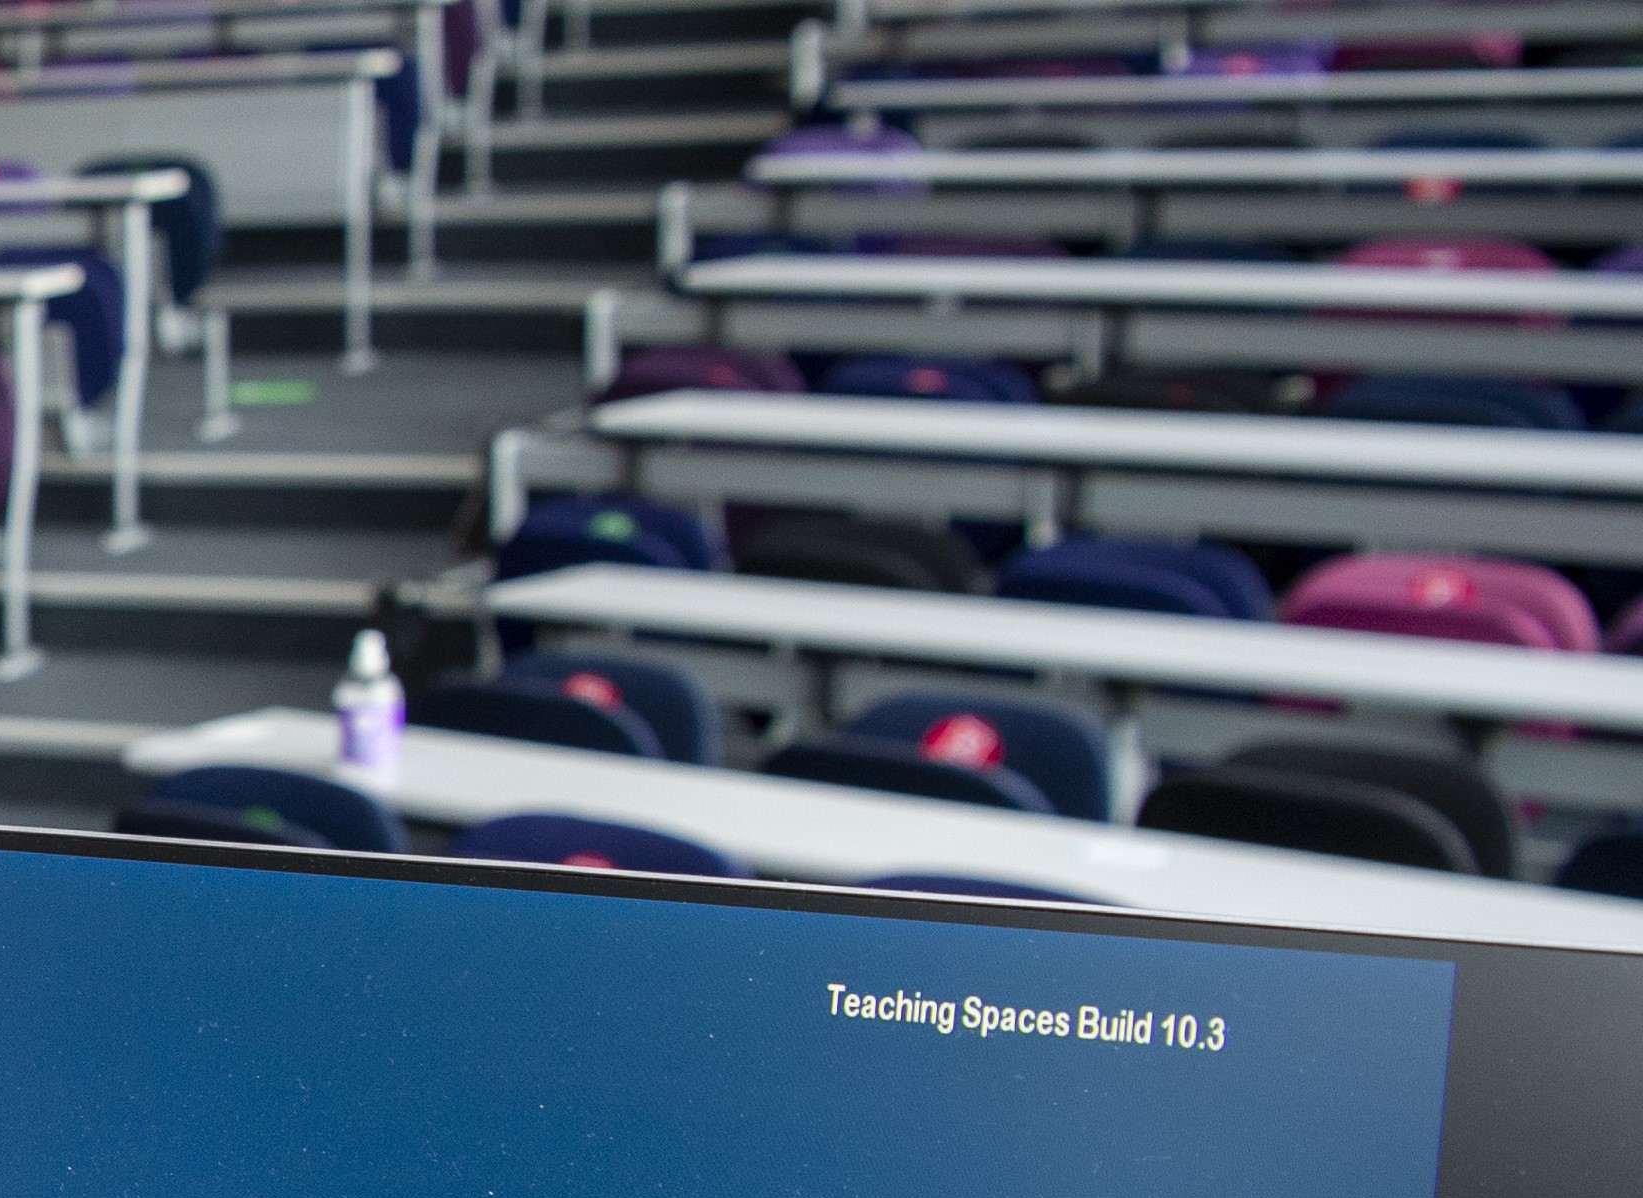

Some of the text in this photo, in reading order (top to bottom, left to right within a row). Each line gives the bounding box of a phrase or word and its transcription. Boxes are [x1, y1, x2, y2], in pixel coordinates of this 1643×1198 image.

[827, 984, 1225, 1050] Teaching Spaces Build 10.3
